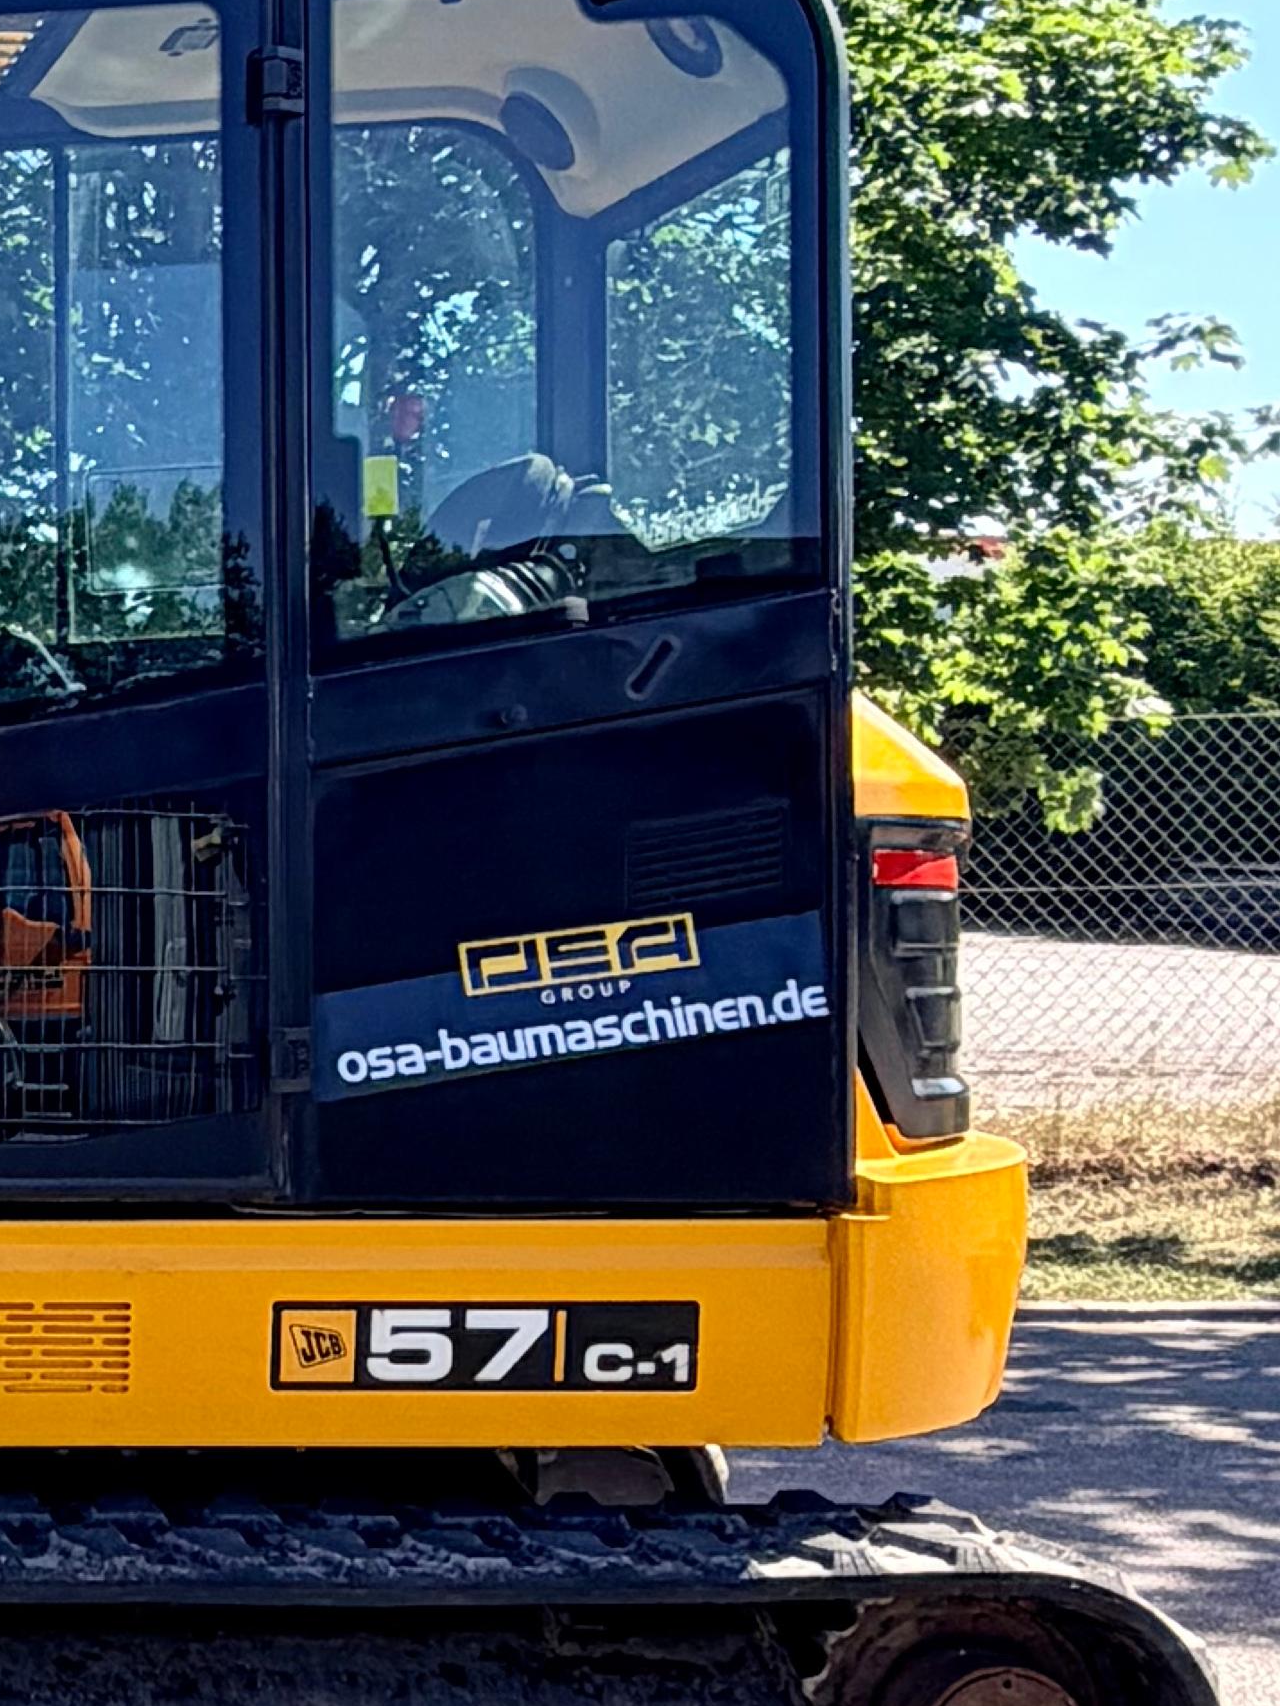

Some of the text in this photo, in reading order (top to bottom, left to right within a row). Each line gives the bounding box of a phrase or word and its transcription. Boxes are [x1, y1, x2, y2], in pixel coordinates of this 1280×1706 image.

[540, 980, 632, 1005] GROUP
[337, 979, 830, 1083] osa-baumaschinen.de
[297, 1309, 690, 1383] JCB 57 C-1
